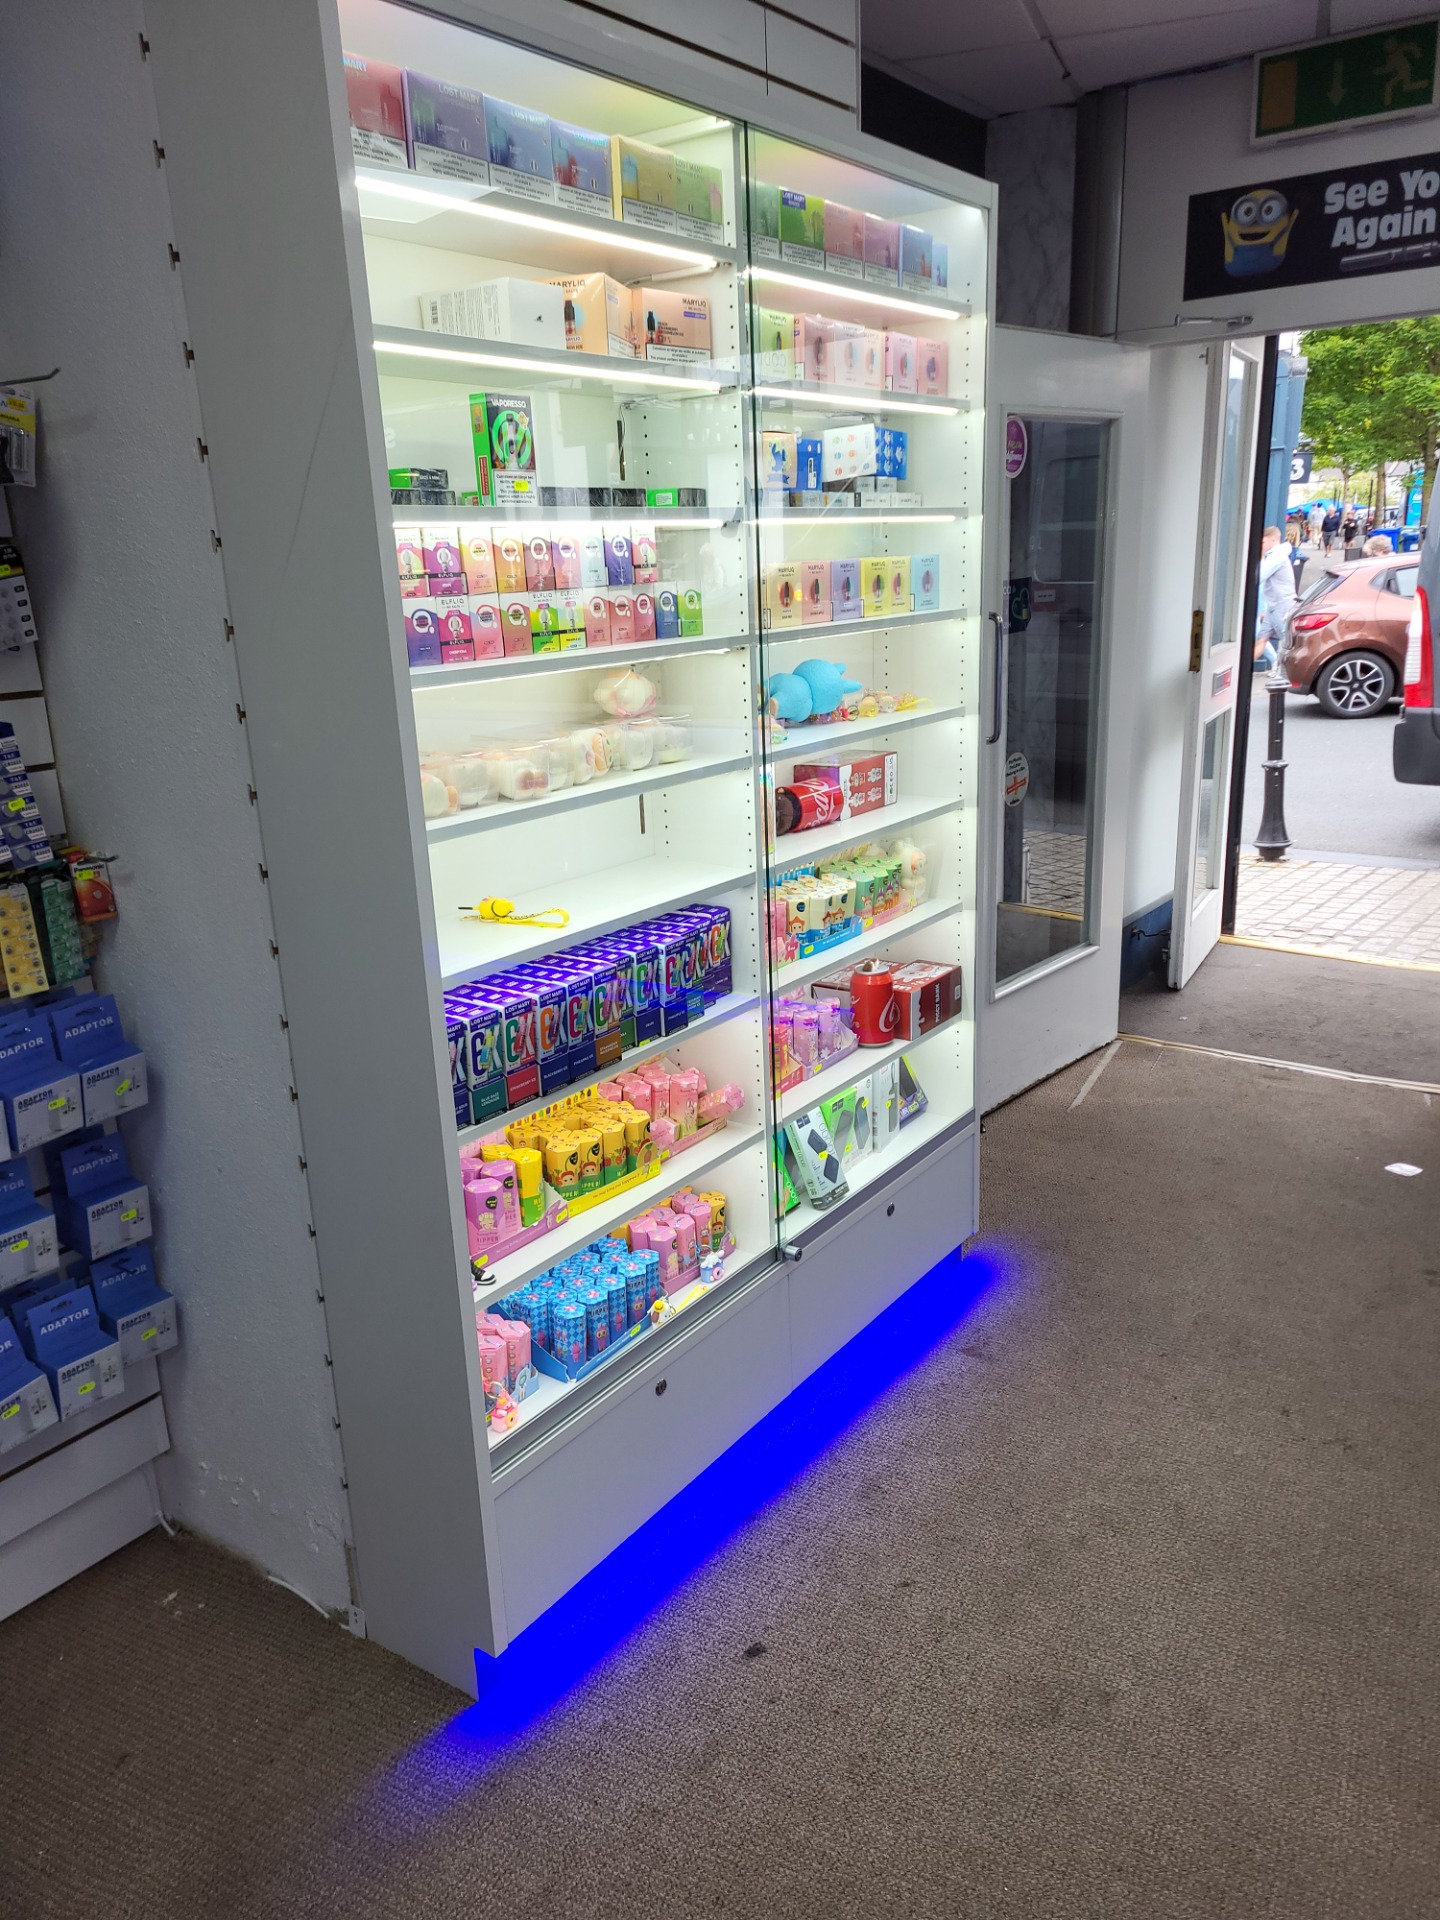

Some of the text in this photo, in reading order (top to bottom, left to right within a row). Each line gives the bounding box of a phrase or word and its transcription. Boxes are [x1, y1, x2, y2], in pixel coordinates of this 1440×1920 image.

[439, 83, 480, 105] LOST MARY
[1324, 169, 1440, 215] See Yo
[1330, 206, 1437, 250] Again
[491, 398, 527, 409] VAPORESSO
[1290, 458, 1305, 481] 3
[441, 598, 465, 606] ELFLIQ
[568, 978, 591, 991] LOST MARY
[540, 989, 564, 1003] LOST MARY
[505, 1000, 531, 1014] LOST MARY
[65, 1016, 114, 1039] ADAPTOR
[447, 1024, 462, 1033] MARY
[470, 1012, 497, 1026] LOST MARY
[0, 1037, 44, 1059] DAPTOR
[87, 1066, 120, 1085] ADAPTOR
[18, 1089, 53, 1110] ADAPTOR
[481, 1097, 500, 1107] LEMONADE
[72, 1153, 119, 1176] ADAPTOR
[91, 1200, 123, 1219] ADAPTOR
[40, 1308, 90, 1335] ADAPTOR
[121, 1311, 151, 1330] ADAPTOR
[61, 1358, 95, 1380] ADAPTOR
